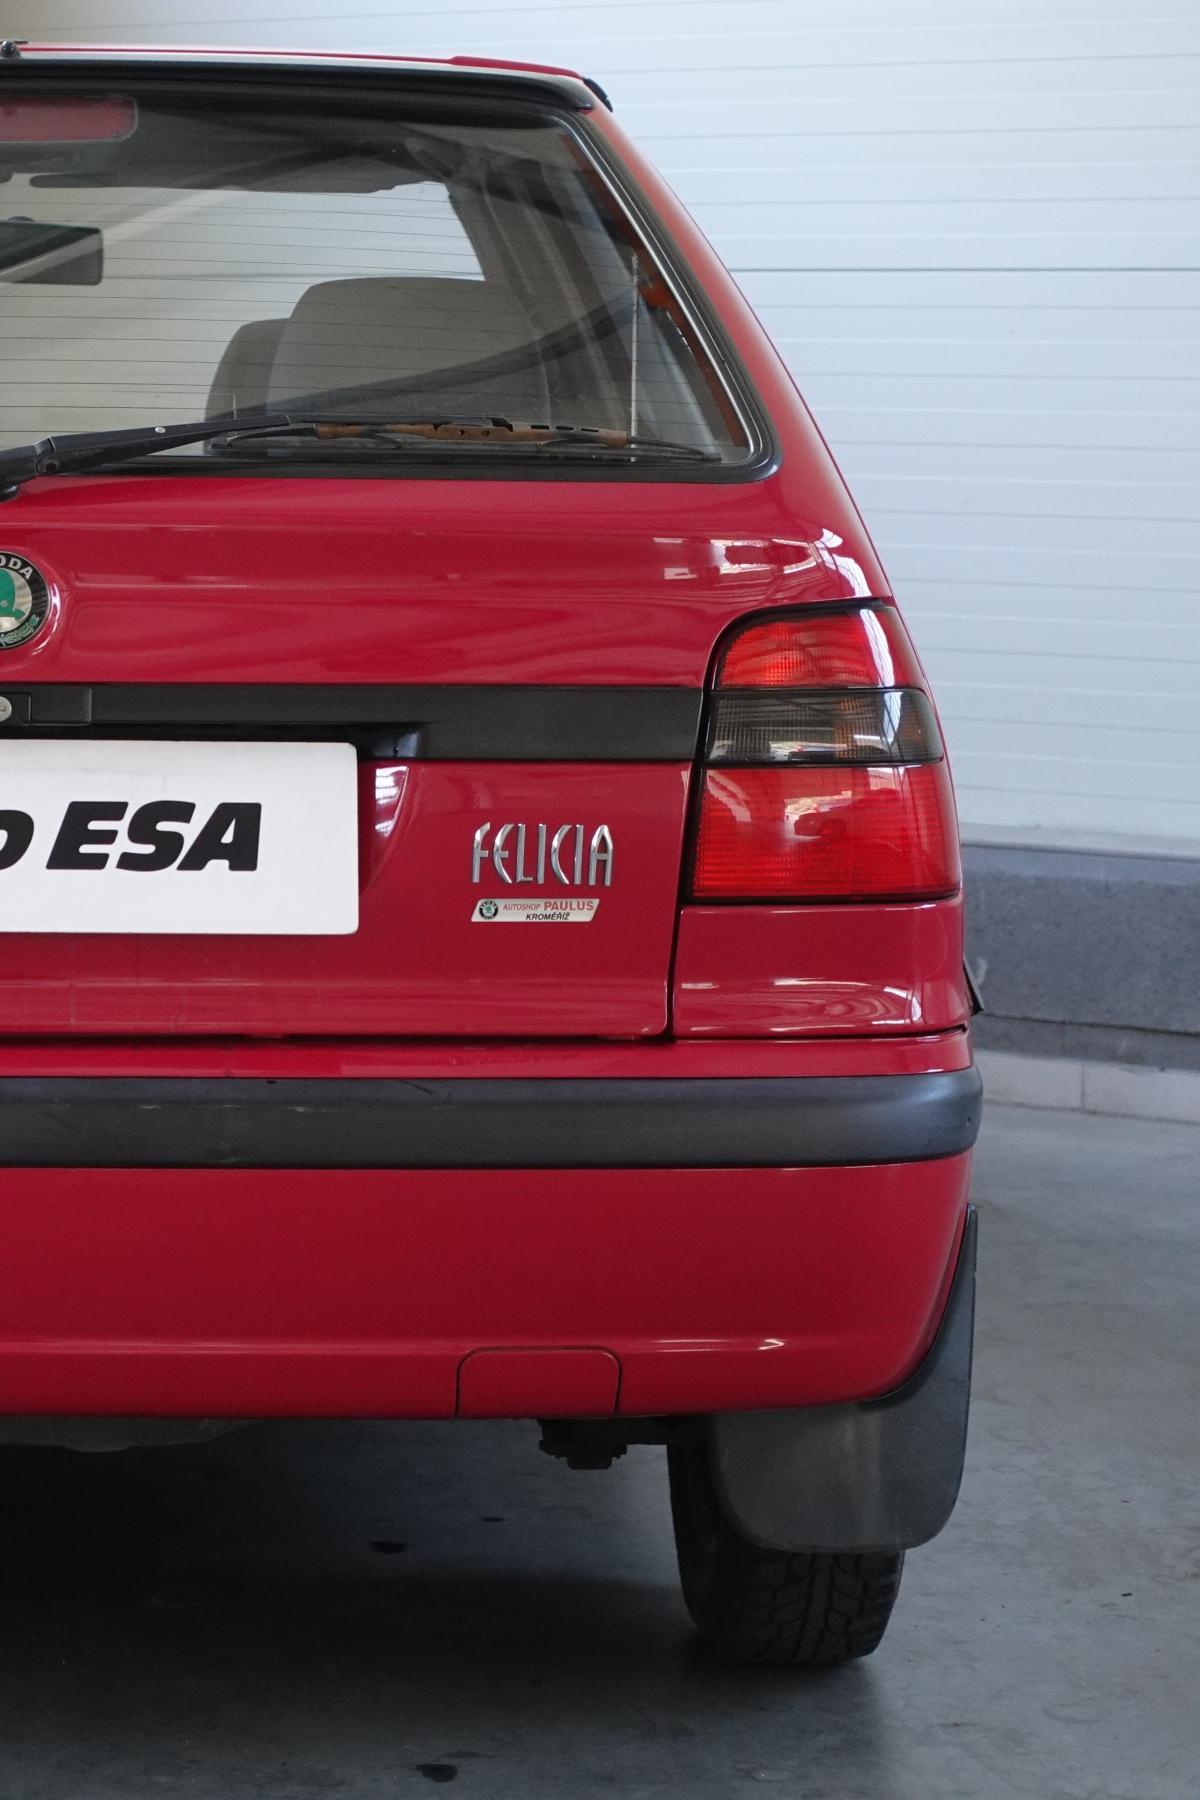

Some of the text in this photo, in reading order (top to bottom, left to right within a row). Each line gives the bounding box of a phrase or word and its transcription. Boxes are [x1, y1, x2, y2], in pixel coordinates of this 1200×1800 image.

[45, 800, 263, 872] ESA
[472, 821, 614, 886] FELICIA
[502, 903, 541, 911] AUTOSHOP
[544, 901, 595, 911] PAULUS
